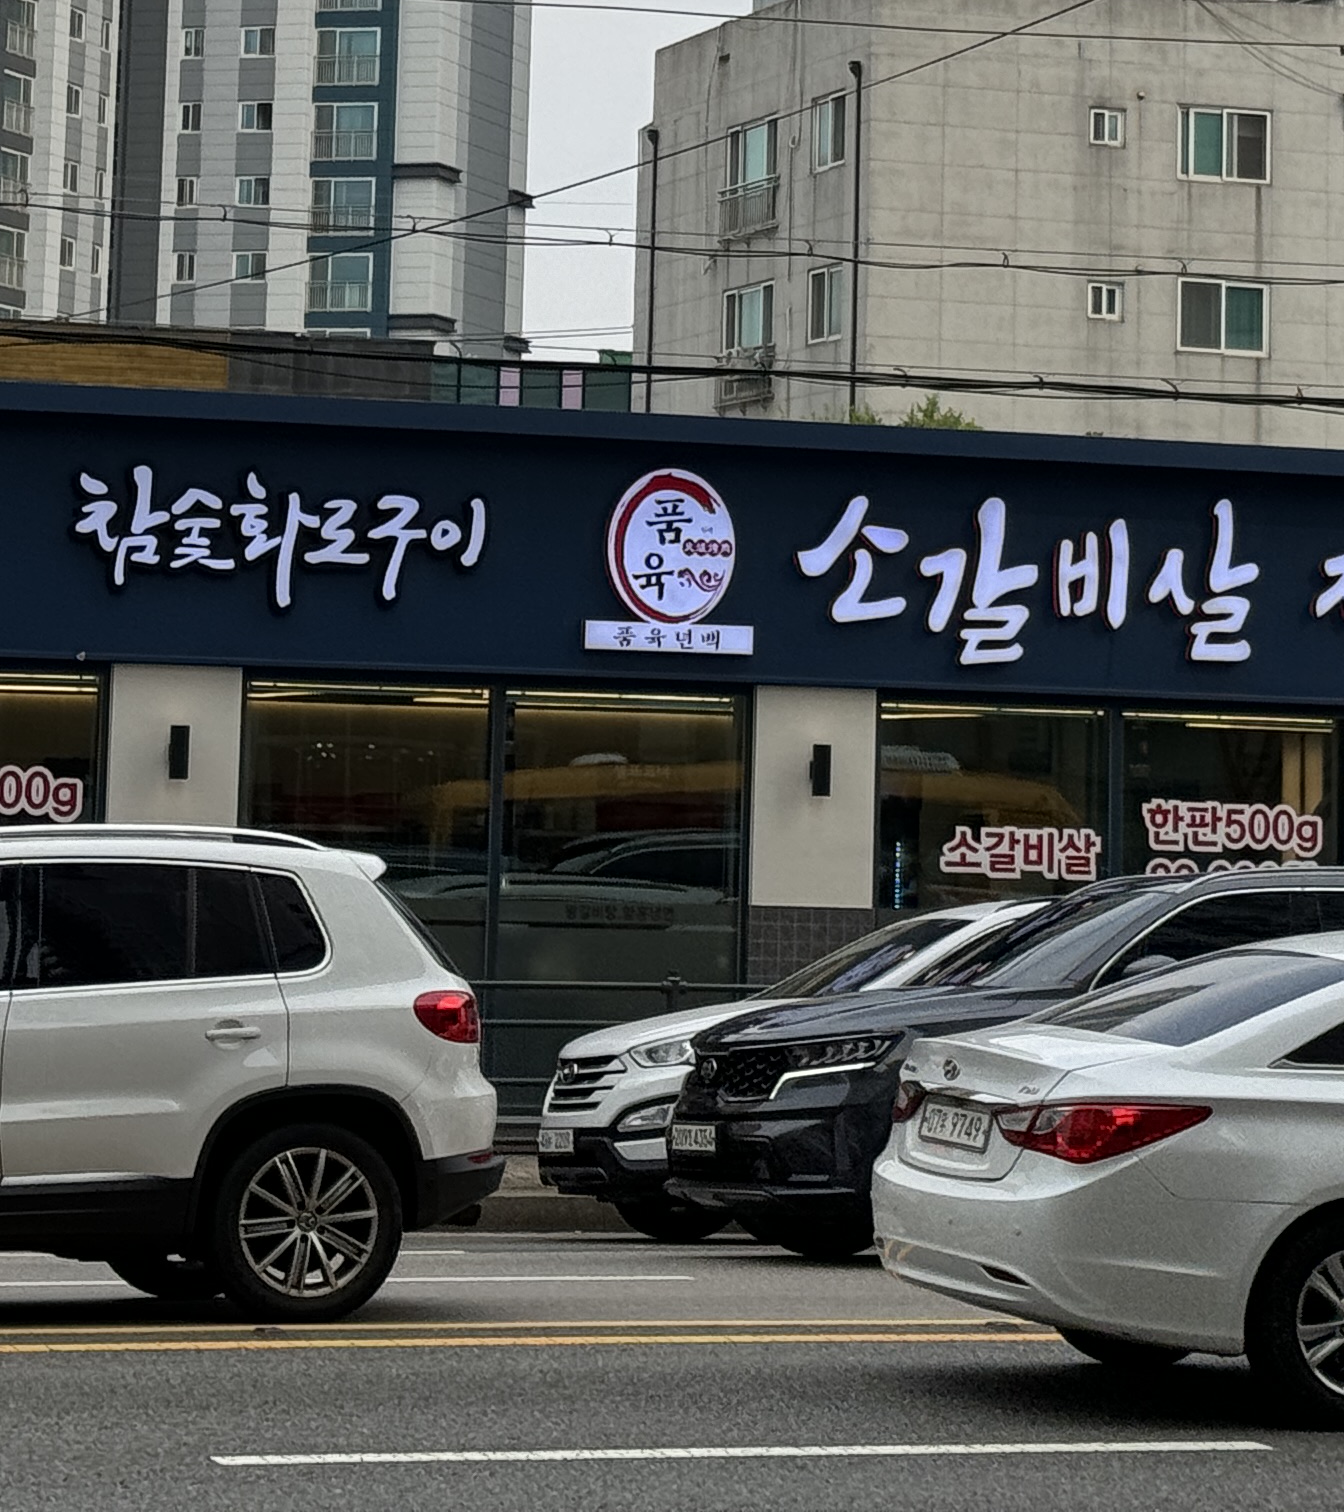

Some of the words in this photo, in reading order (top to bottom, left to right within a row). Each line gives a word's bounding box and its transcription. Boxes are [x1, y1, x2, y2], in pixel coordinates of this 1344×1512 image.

[75, 465, 485, 606] 참숯화로구이
[797, 495, 1259, 667] 소갈비살
[942, 828, 1100, 878] 소갈비살
[1146, 802, 1321, 857] 한판500g
